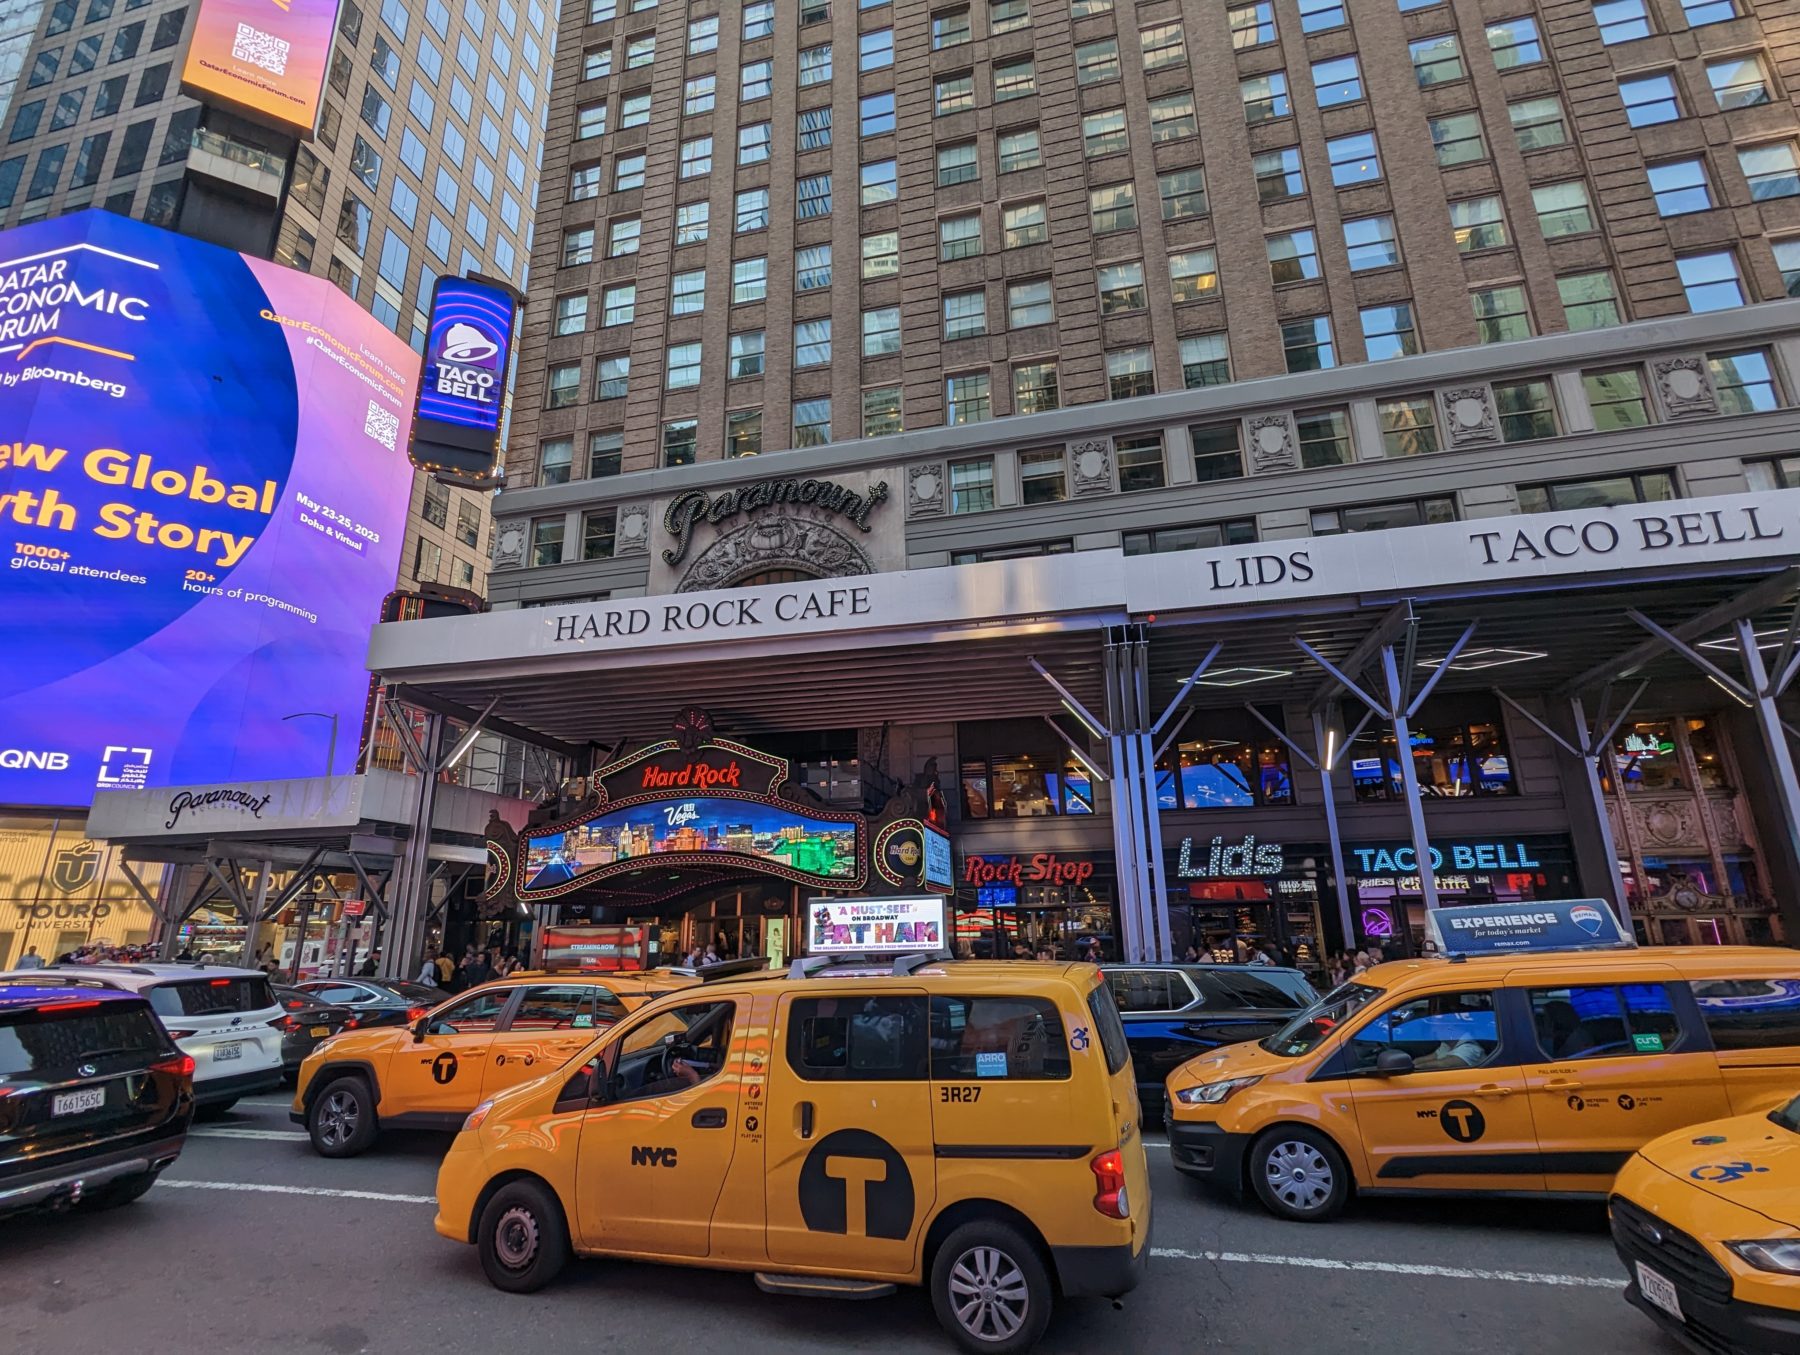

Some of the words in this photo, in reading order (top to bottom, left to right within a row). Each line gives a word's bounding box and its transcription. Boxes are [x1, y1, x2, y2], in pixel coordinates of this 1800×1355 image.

[200, 59, 306, 106] QatarEconomicForum.com
[260, 309, 404, 397] QatarEconomicForum.com
[359, 343, 384, 368] Learn
[384, 364, 406, 386] more
[3, 373, 20, 388] by
[22, 366, 127, 398] Bloomberg
[306, 336, 402, 408] #QatarEconomicForum
[436, 363, 494, 388] TACO
[437, 378, 493, 403] BELL
[83, 448, 277, 514] Global
[296, 492, 321, 513] May
[321, 506, 353, 531] 23-25,
[355, 524, 380, 543] 2023
[300, 512, 325, 532] Doha
[325, 526, 334, 537] &
[334, 530, 363, 551] Virtual
[661, 478, 888, 566] Paramount
[93, 503, 254, 567] Story
[1469, 520, 1620, 565] TACO
[1632, 506, 1784, 552] BELL
[15, 542, 71, 561] 1000+
[10, 555, 65, 574] global
[69, 563, 147, 584] attendees
[185, 569, 216, 583] 20+
[1206, 551, 1314, 591] LIDS
[182, 580, 224, 597] hours
[227, 587, 243, 599] of
[245, 590, 317, 624] programming
[554, 608, 650, 643] HARD
[661, 597, 763, 632] ROCK
[775, 585, 872, 622] CAFE
[0, 749, 69, 770] QNB
[642, 763, 692, 788] Hard
[692, 760, 741, 790] Rock
[165, 789, 270, 829] Paramount
[664, 804, 700, 826] Vegas
[889, 845, 909, 855] Hard
[1177, 834, 1284, 878] Lids
[1354, 846, 1443, 872] TACO
[1453, 843, 1540, 869] BELL
[964, 855, 1024, 889] Rock
[1028, 852, 1094, 887] Shop
[15, 903, 111, 919] TOURO
[15, 920, 106, 930] UNIVERSITY
[1451, 913, 1557, 929] EXPERIENCE
[814, 923, 872, 945] FAT
[875, 921, 939, 943] HAM
[1474, 929, 1485, 938] for
[1487, 927, 1514, 937] today's
[1515, 927, 1541, 935] market
[211, 1026, 257, 1034] SIENNA
[1637, 1036, 1660, 1044] curb
[977, 1053, 1005, 1062] ARRO
[941, 1087, 981, 1102] 3R27
[1416, 1110, 1438, 1118] NYC
[1448, 1108, 1472, 1138] T
[631, 1146, 677, 1168] NYC
[824, 1154, 887, 1240] T
